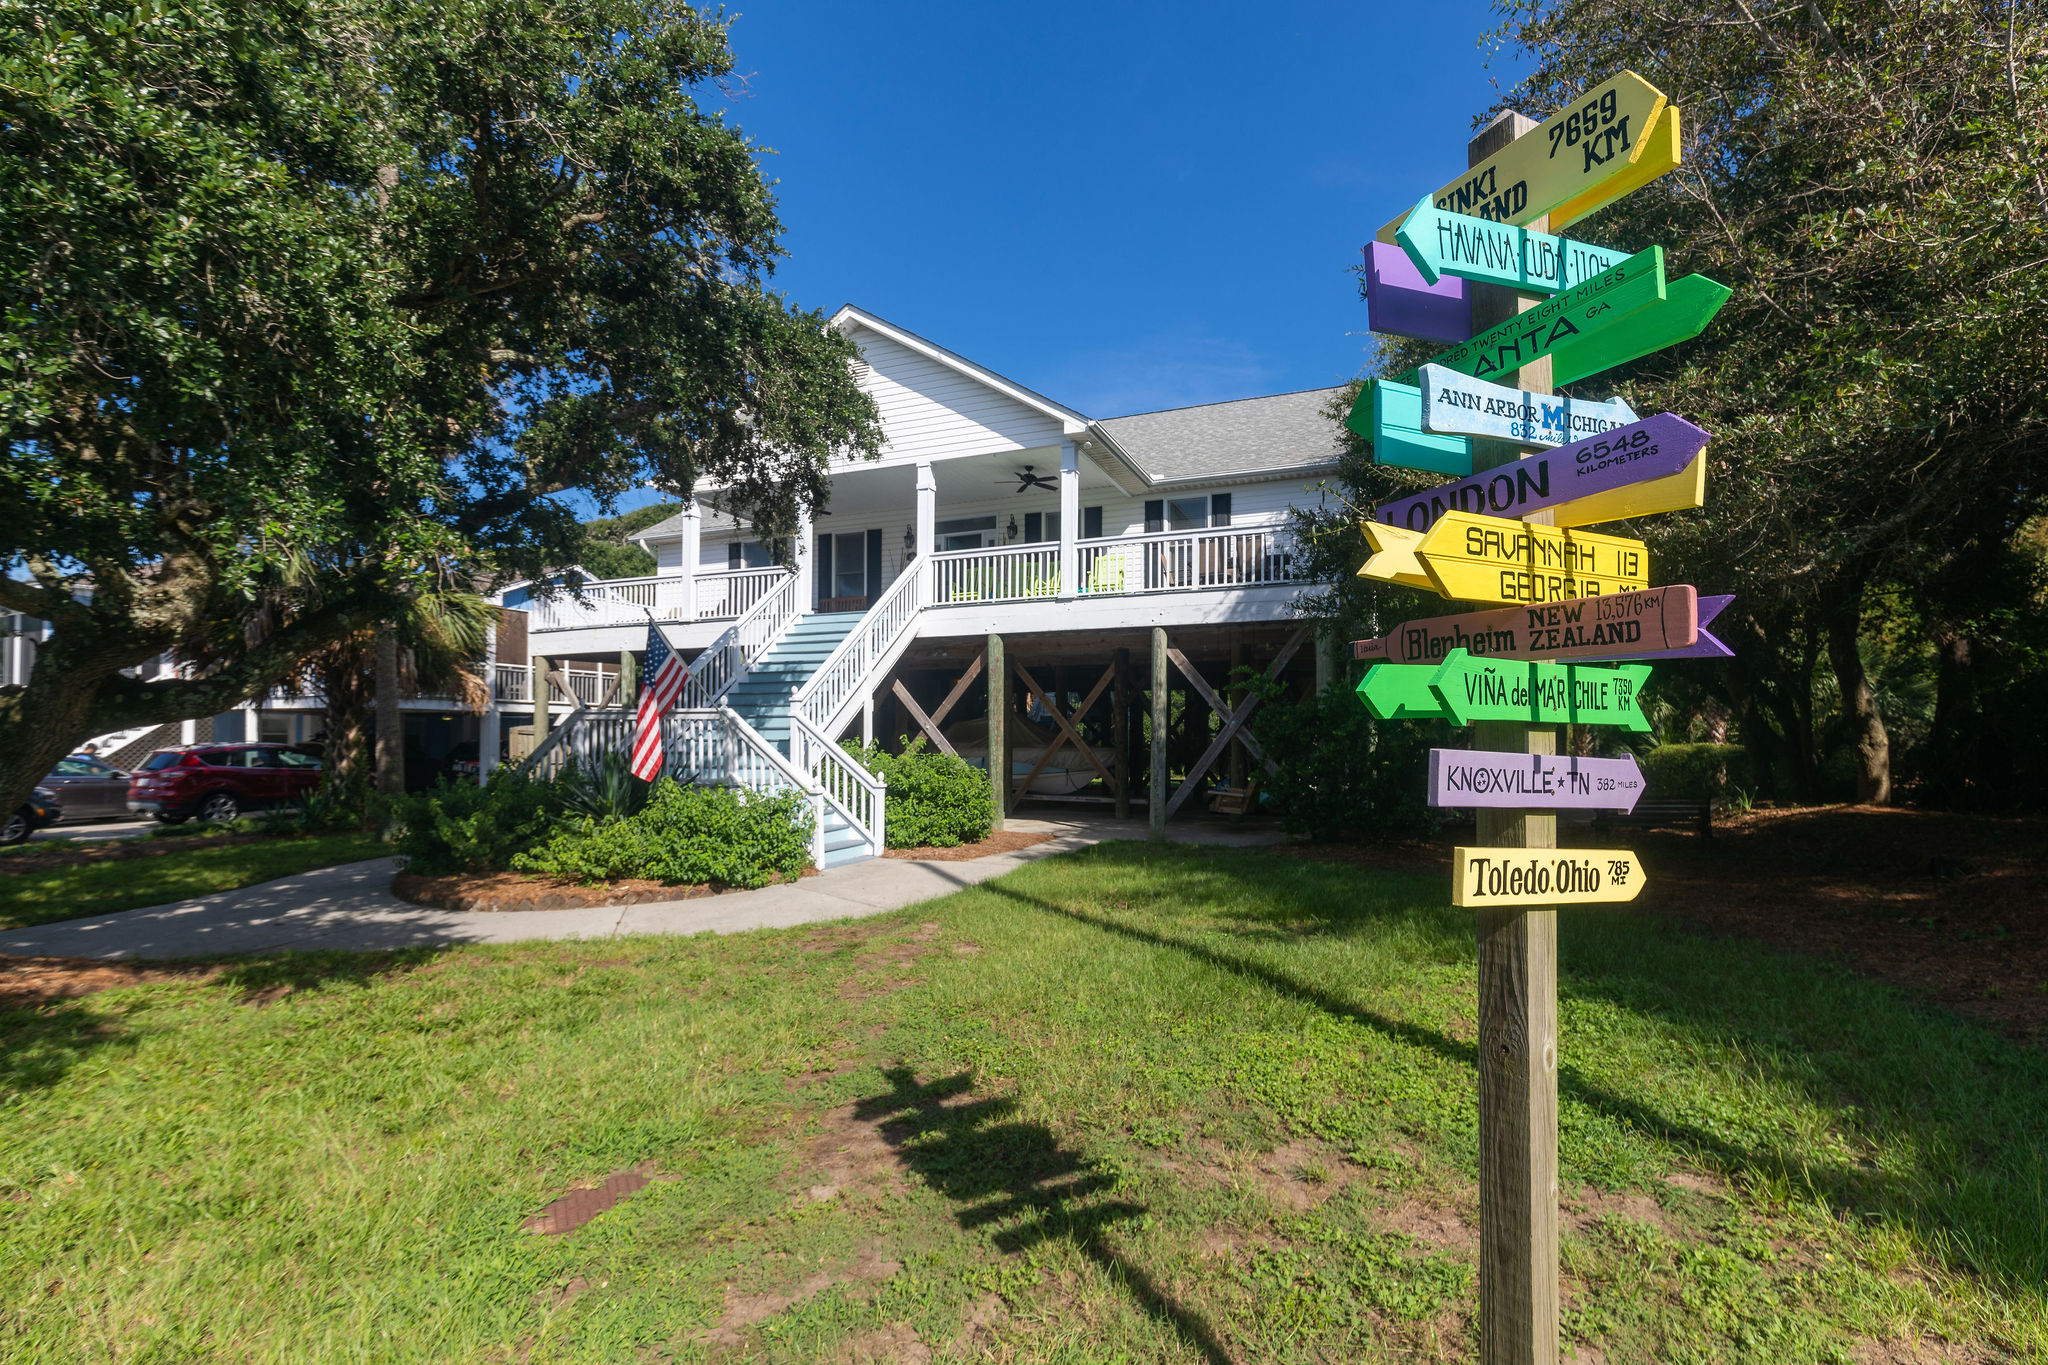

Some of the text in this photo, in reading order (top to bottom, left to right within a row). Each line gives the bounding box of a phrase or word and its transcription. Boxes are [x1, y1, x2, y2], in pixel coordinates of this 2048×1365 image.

[1549, 88, 1617, 160] 7659
[1583, 114, 1631, 174] KM
[1437, 218, 1517, 275] HAVANA
[1523, 237, 1569, 284] CUBA
[1437, 268, 1625, 371] DRED TWENTY EIGHT MILES
[1585, 301, 1612, 319] GA
[1437, 387, 1482, 412] ANN
[1483, 399, 1541, 424] ARBOR
[1510, 422, 1538, 440] 832
[1575, 429, 1650, 464] 6548
[1576, 445, 1659, 477] KILOMETERS
[1466, 526, 1639, 577] SAVANNAH 113
[1500, 570, 1601, 603] GEORGIA
[1527, 593, 1661, 629] NEW 13,576 KM
[1406, 623, 1517, 661] Blenheim
[1529, 619, 1642, 652] ZEALAND
[1464, 667, 1608, 711] VIÑA del MAR CHILE
[1613, 677, 1633, 696] 7350
[1618, 696, 1631, 711] KM
[1447, 764, 1638, 796] KNOXVILLE TN 382 MILES
[1469, 858, 1601, 897] Toledo Ohio
[1607, 860, 1630, 877] 785
[1611, 875, 1627, 886] MI
